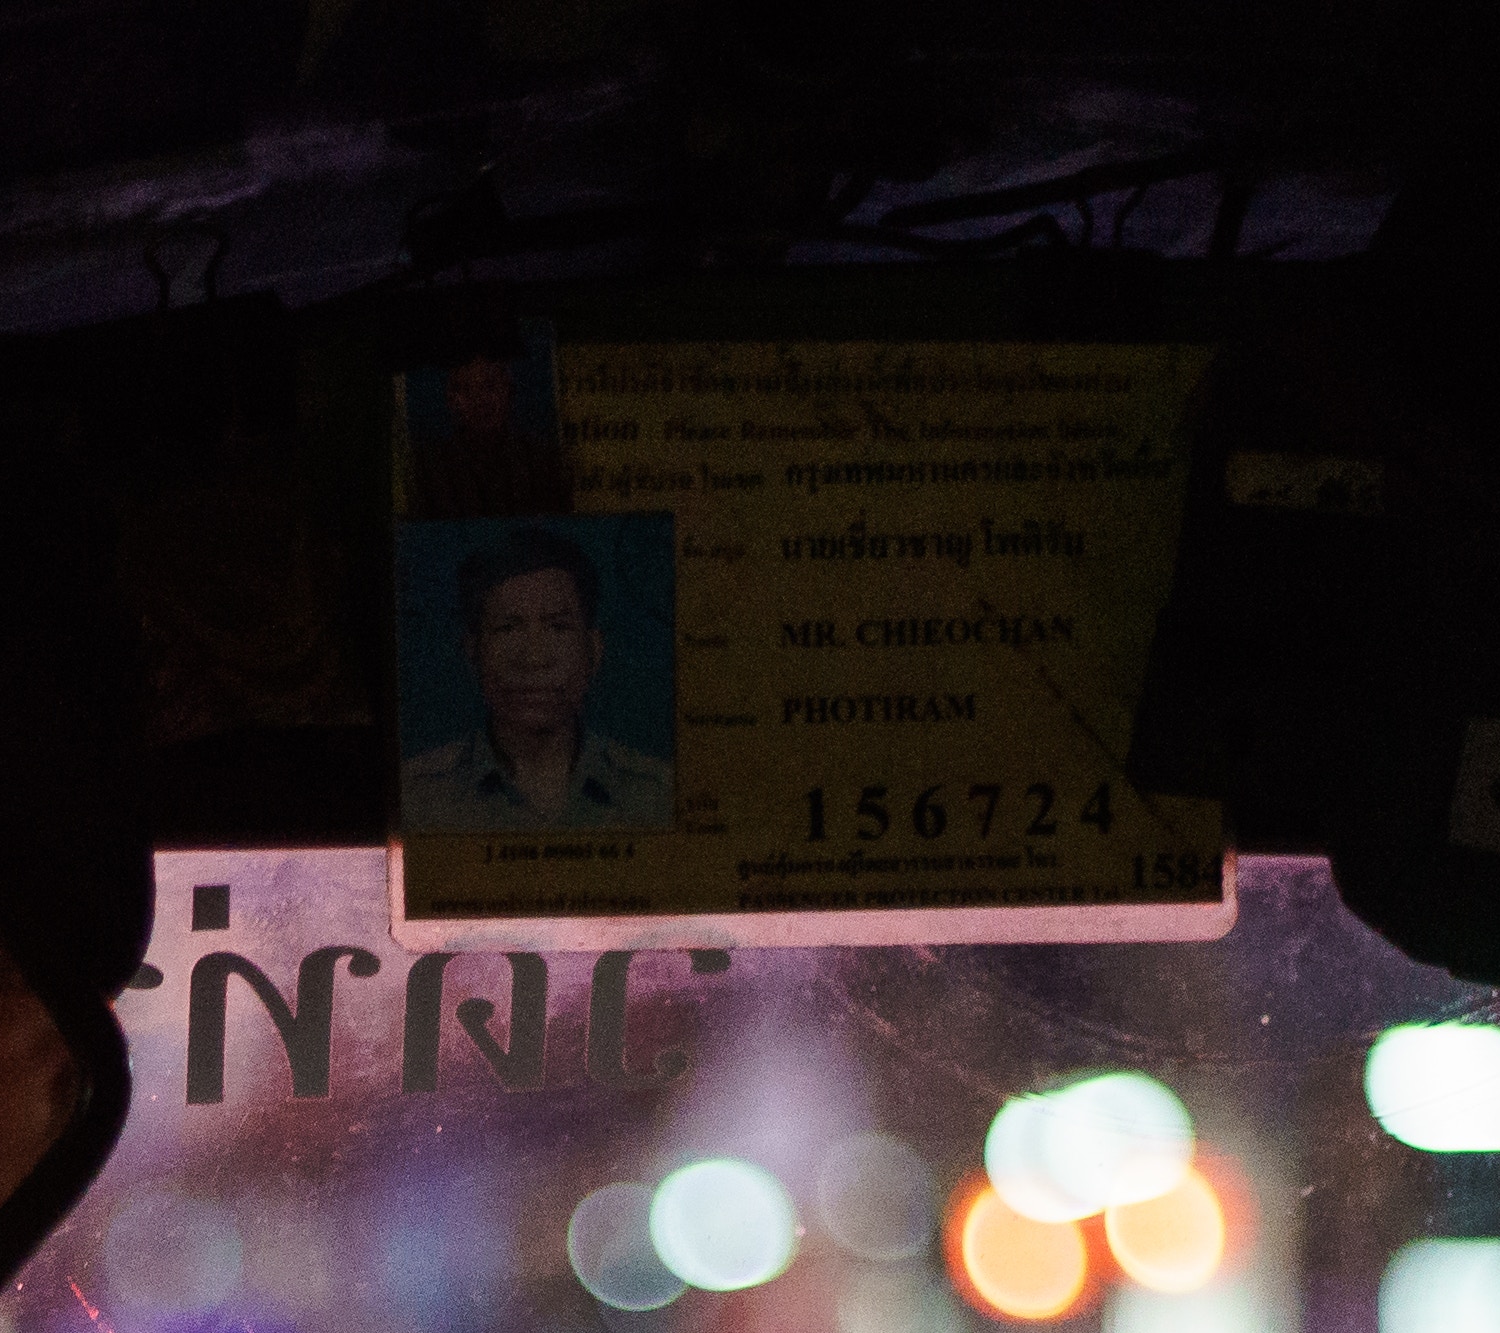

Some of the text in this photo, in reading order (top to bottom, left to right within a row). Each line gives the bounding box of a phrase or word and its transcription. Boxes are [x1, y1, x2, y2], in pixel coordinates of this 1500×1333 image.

[782, 620, 846, 648] MR.
[856, 616, 1076, 648] CHIEOCHAN
[782, 693, 978, 725] PHOTIRAM
[864, 887, 997, 905] PROTECTION
[1002, 885, 1085, 903] CENTER
